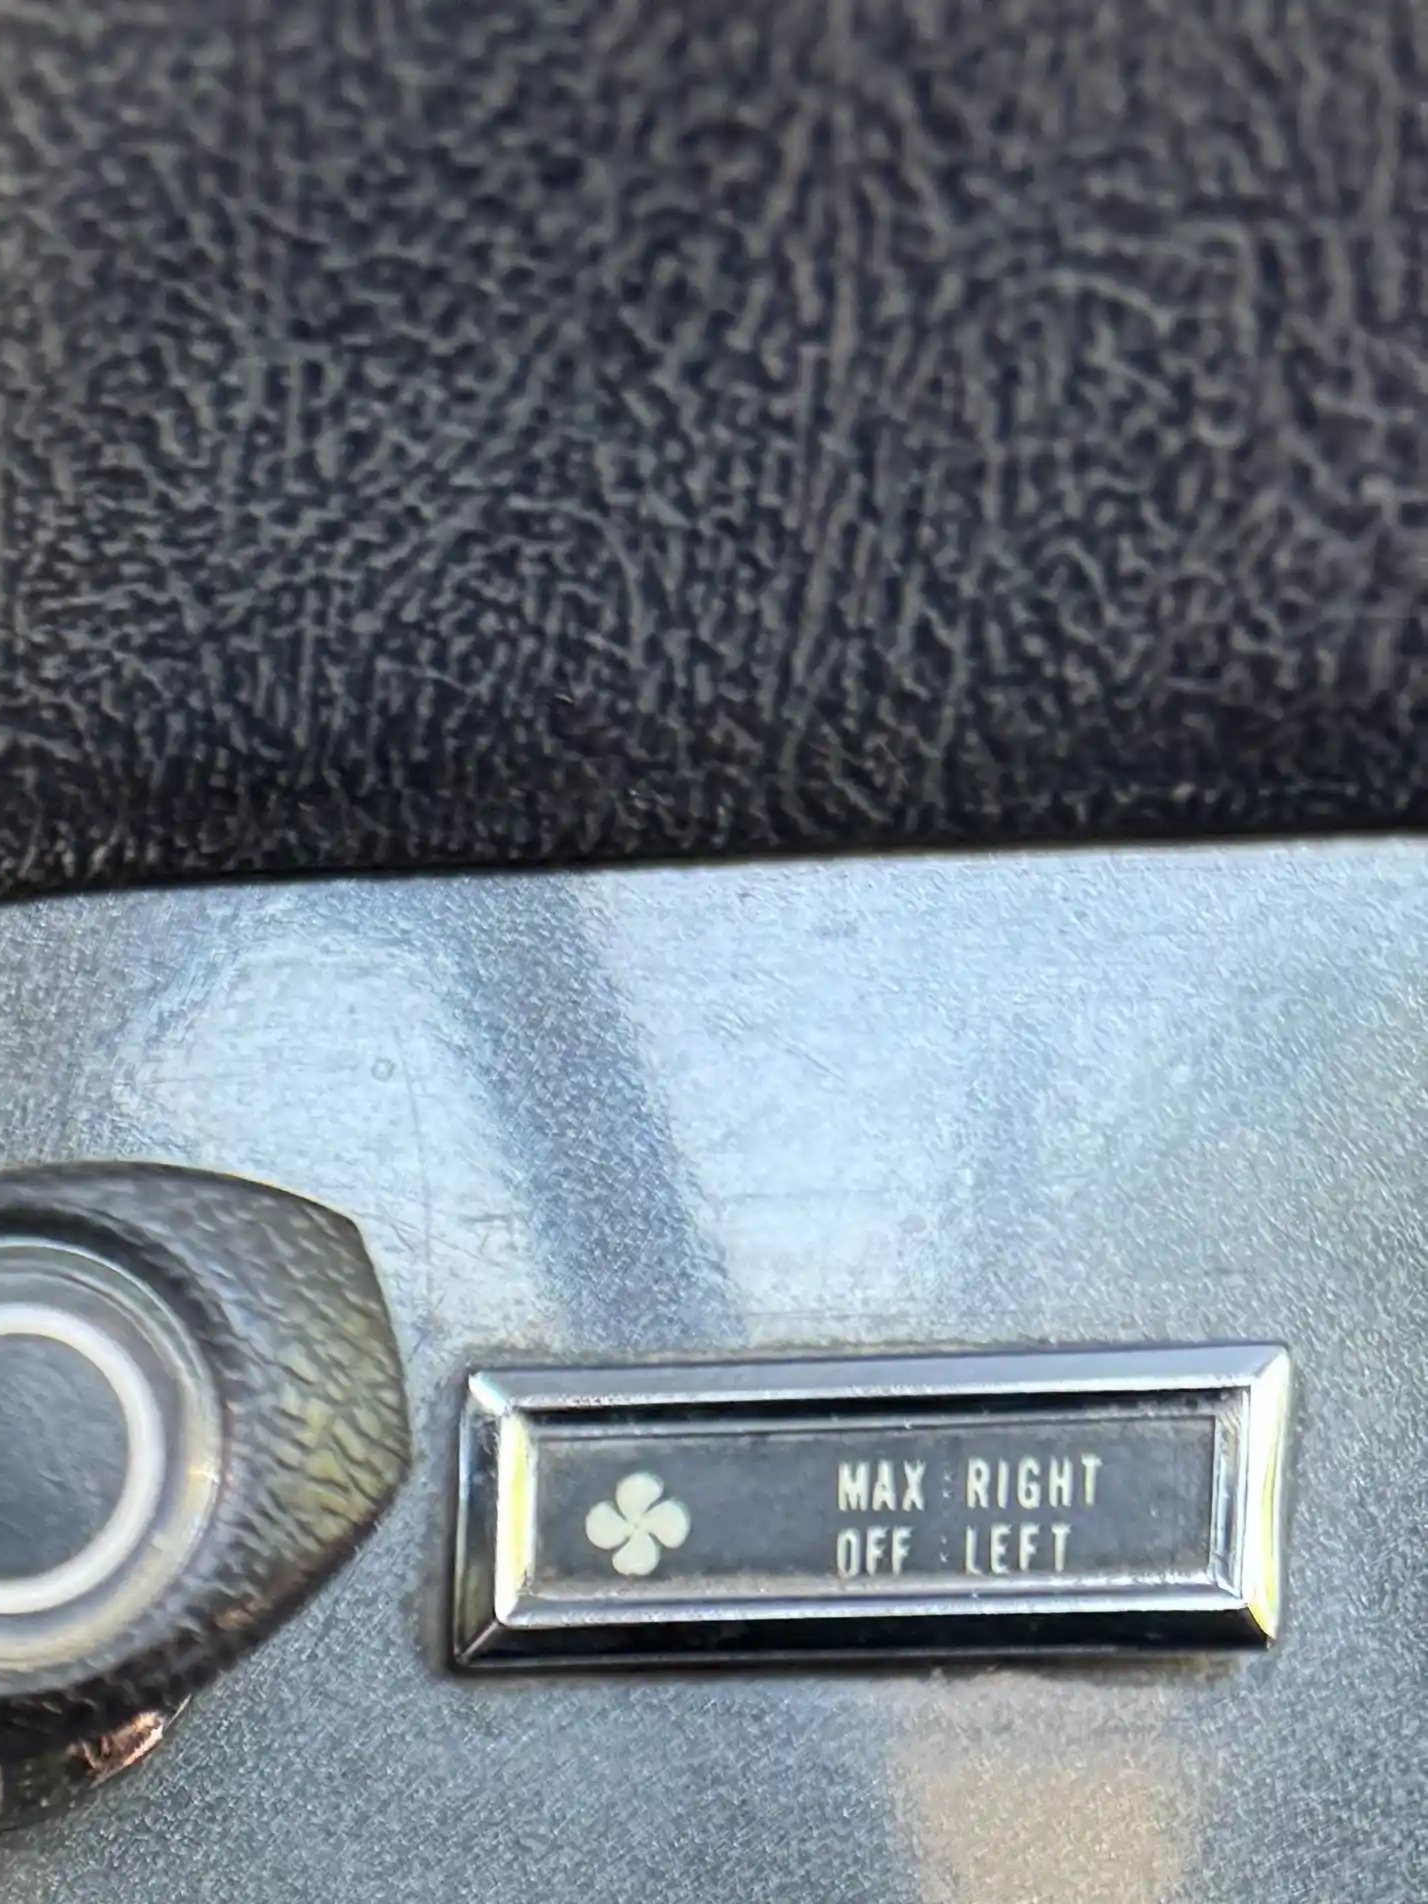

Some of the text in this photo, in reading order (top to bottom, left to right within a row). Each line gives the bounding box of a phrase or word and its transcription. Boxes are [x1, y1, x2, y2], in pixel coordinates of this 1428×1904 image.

[836, 1454, 1103, 1512] MAX RIGHT
[835, 1523, 1072, 1577] OFF LEFT
